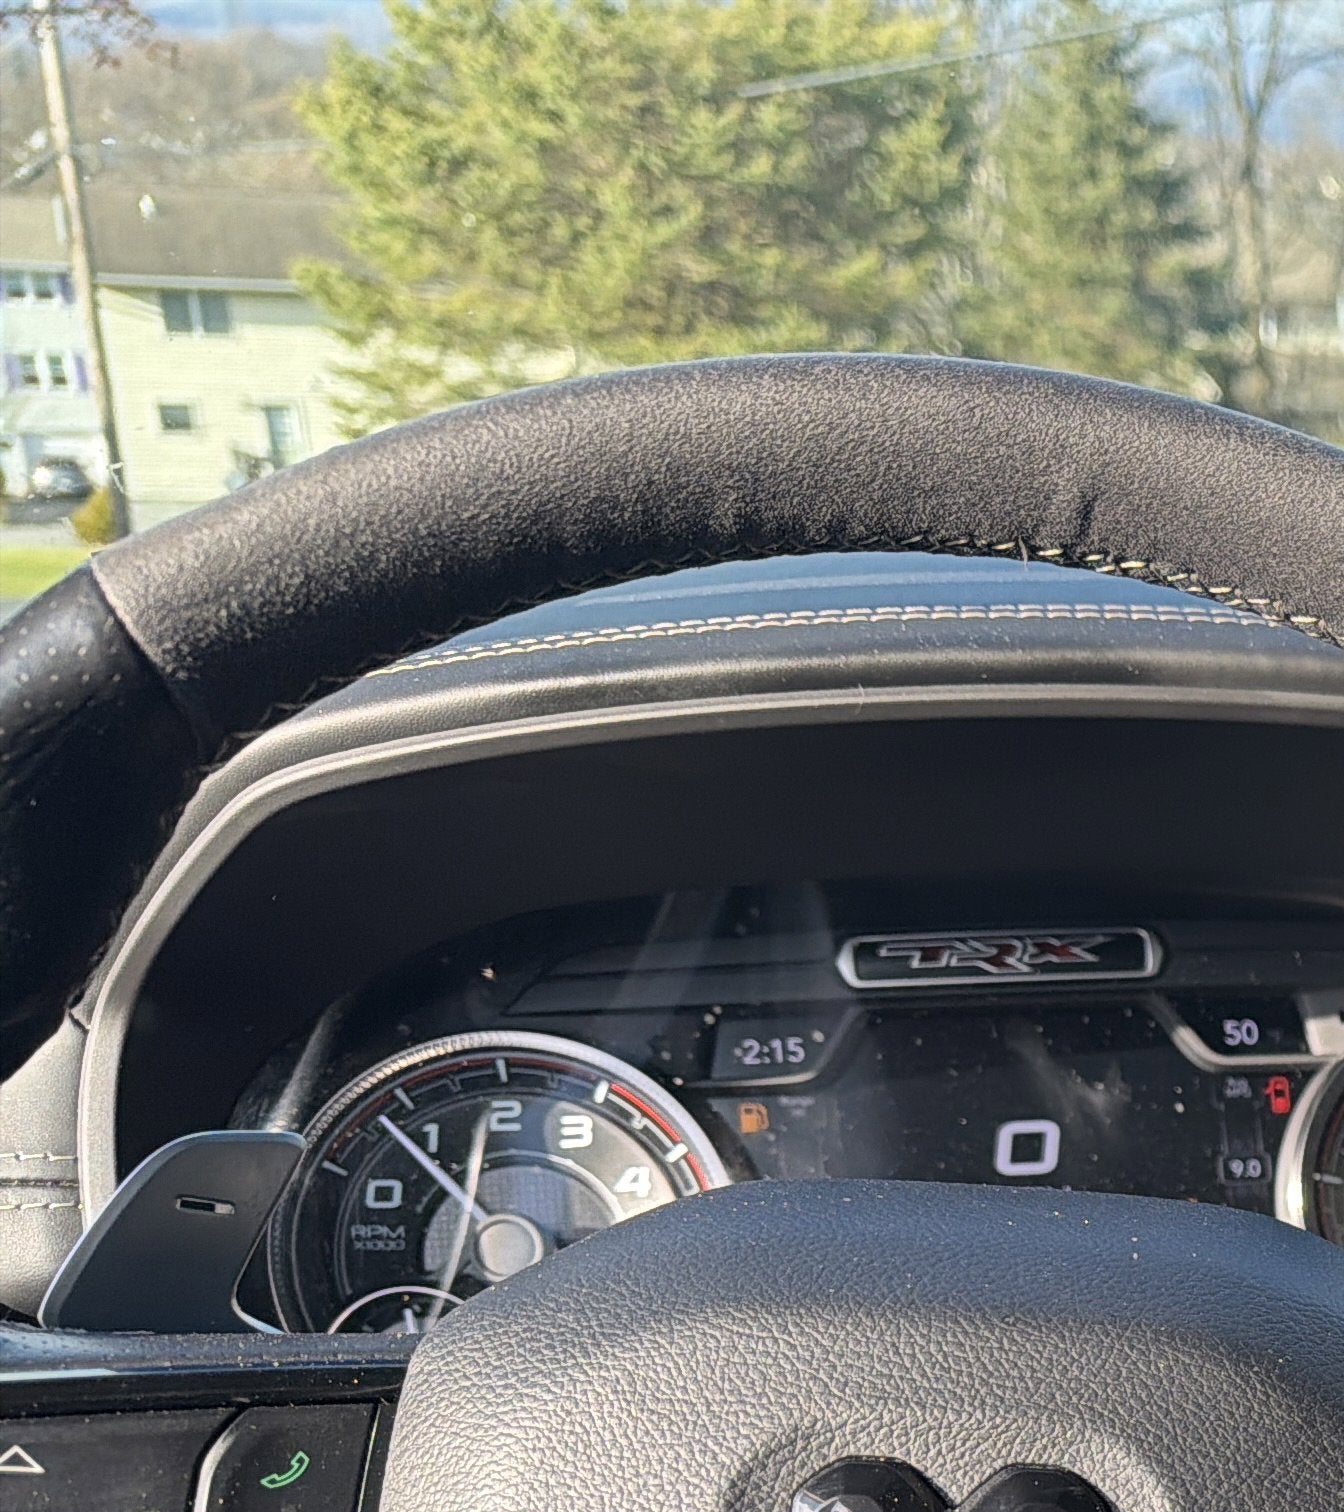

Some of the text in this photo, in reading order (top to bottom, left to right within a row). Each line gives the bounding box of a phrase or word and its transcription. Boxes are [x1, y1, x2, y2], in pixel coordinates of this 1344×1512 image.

[878, 936, 1110, 974] TRX
[1223, 1018, 1260, 1046] 50
[742, 1036, 806, 1065] 2:15
[488, 1100, 522, 1131] 2
[421, 1122, 440, 1153] 1
[557, 1114, 594, 1149] 3
[994, 1119, 1061, 1177] 0
[365, 1178, 404, 1209] 0
[614, 1166, 652, 1198] 4
[350, 1224, 406, 1240] RPM
